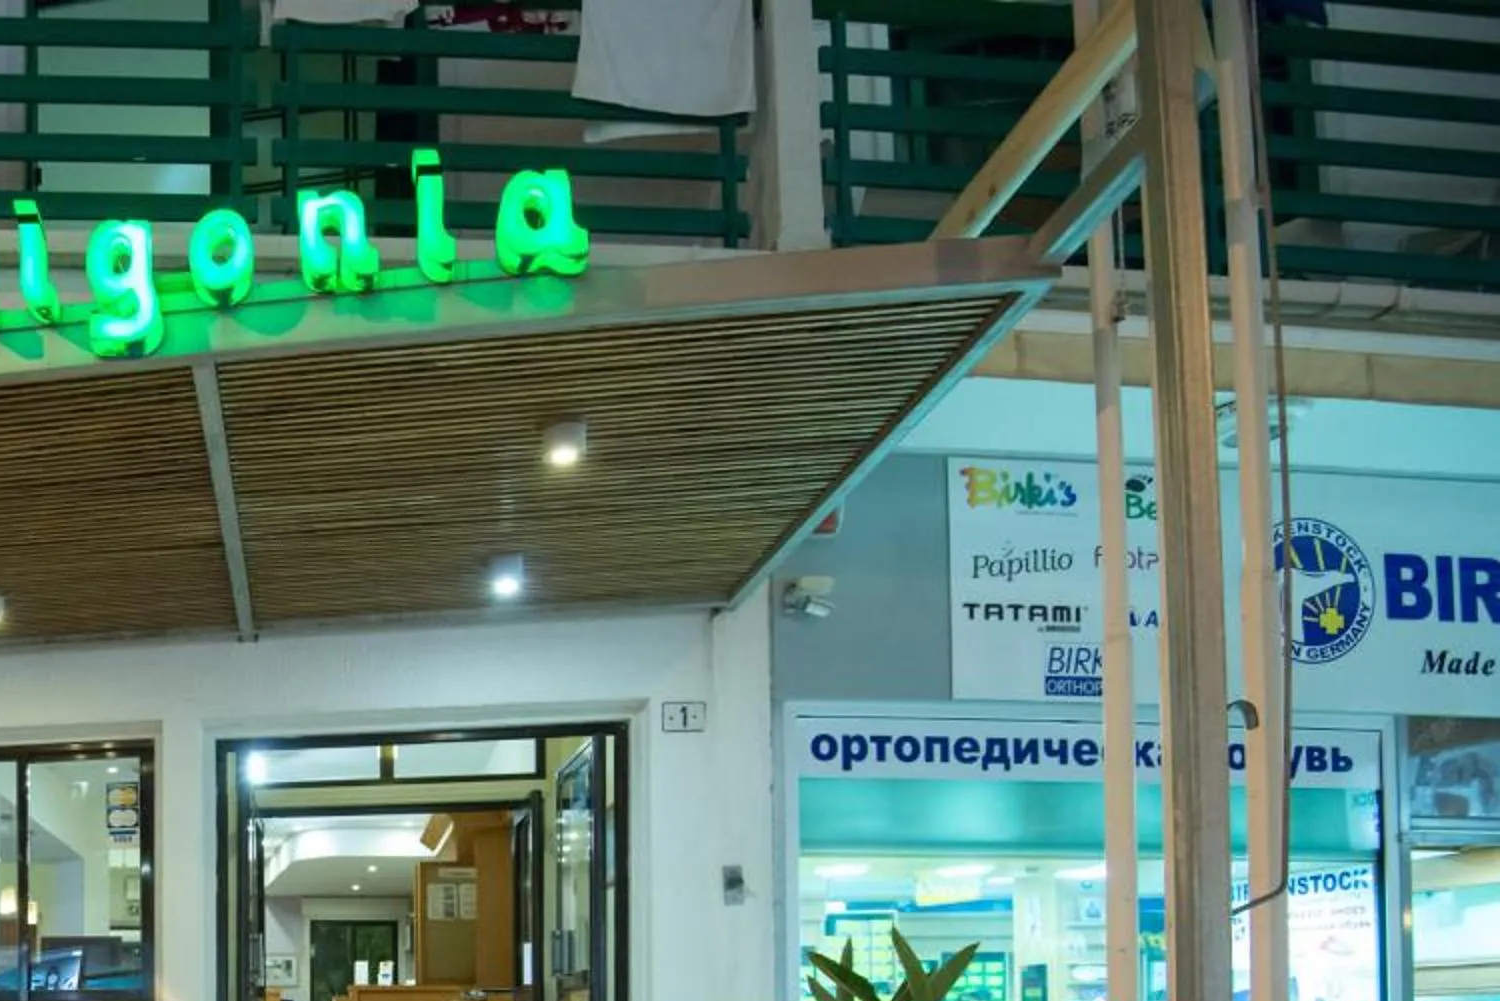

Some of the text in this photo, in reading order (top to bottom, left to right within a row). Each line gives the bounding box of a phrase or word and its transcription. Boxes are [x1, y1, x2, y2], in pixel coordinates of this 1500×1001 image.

[959, 466, 1078, 511] Birki's
[972, 548, 1074, 582] Papillio
[963, 602, 1081, 623] TATAMI
[1305, 602, 1372, 661] GERMANY
[1420, 649, 1496, 677] Made
